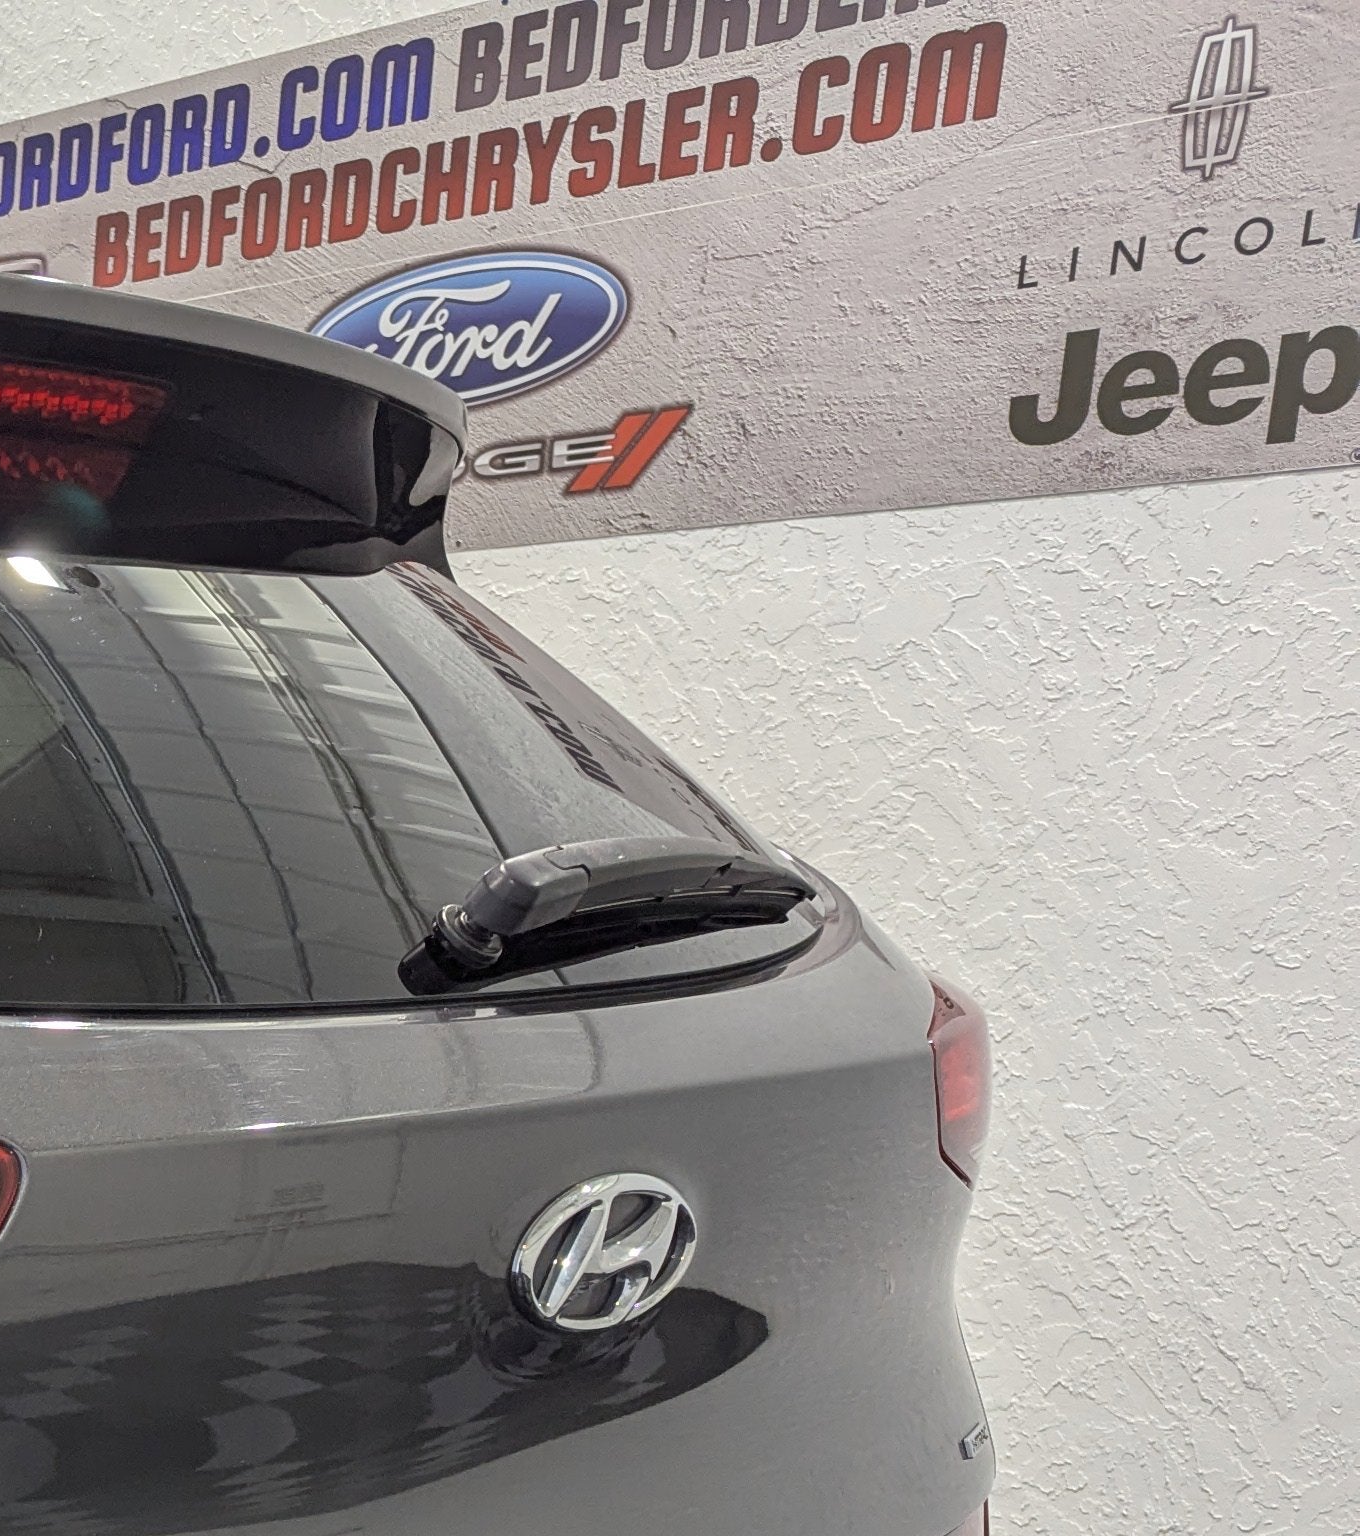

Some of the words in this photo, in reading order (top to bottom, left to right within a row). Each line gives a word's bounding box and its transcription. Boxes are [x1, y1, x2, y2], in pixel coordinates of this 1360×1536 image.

[92, 21, 1008, 288] BEDFORDCHRYSLER.COM
[1017, 202, 1360, 290] LINCOL
[364, 279, 562, 379] Ford
[1008, 324, 1360, 446] Jeep
